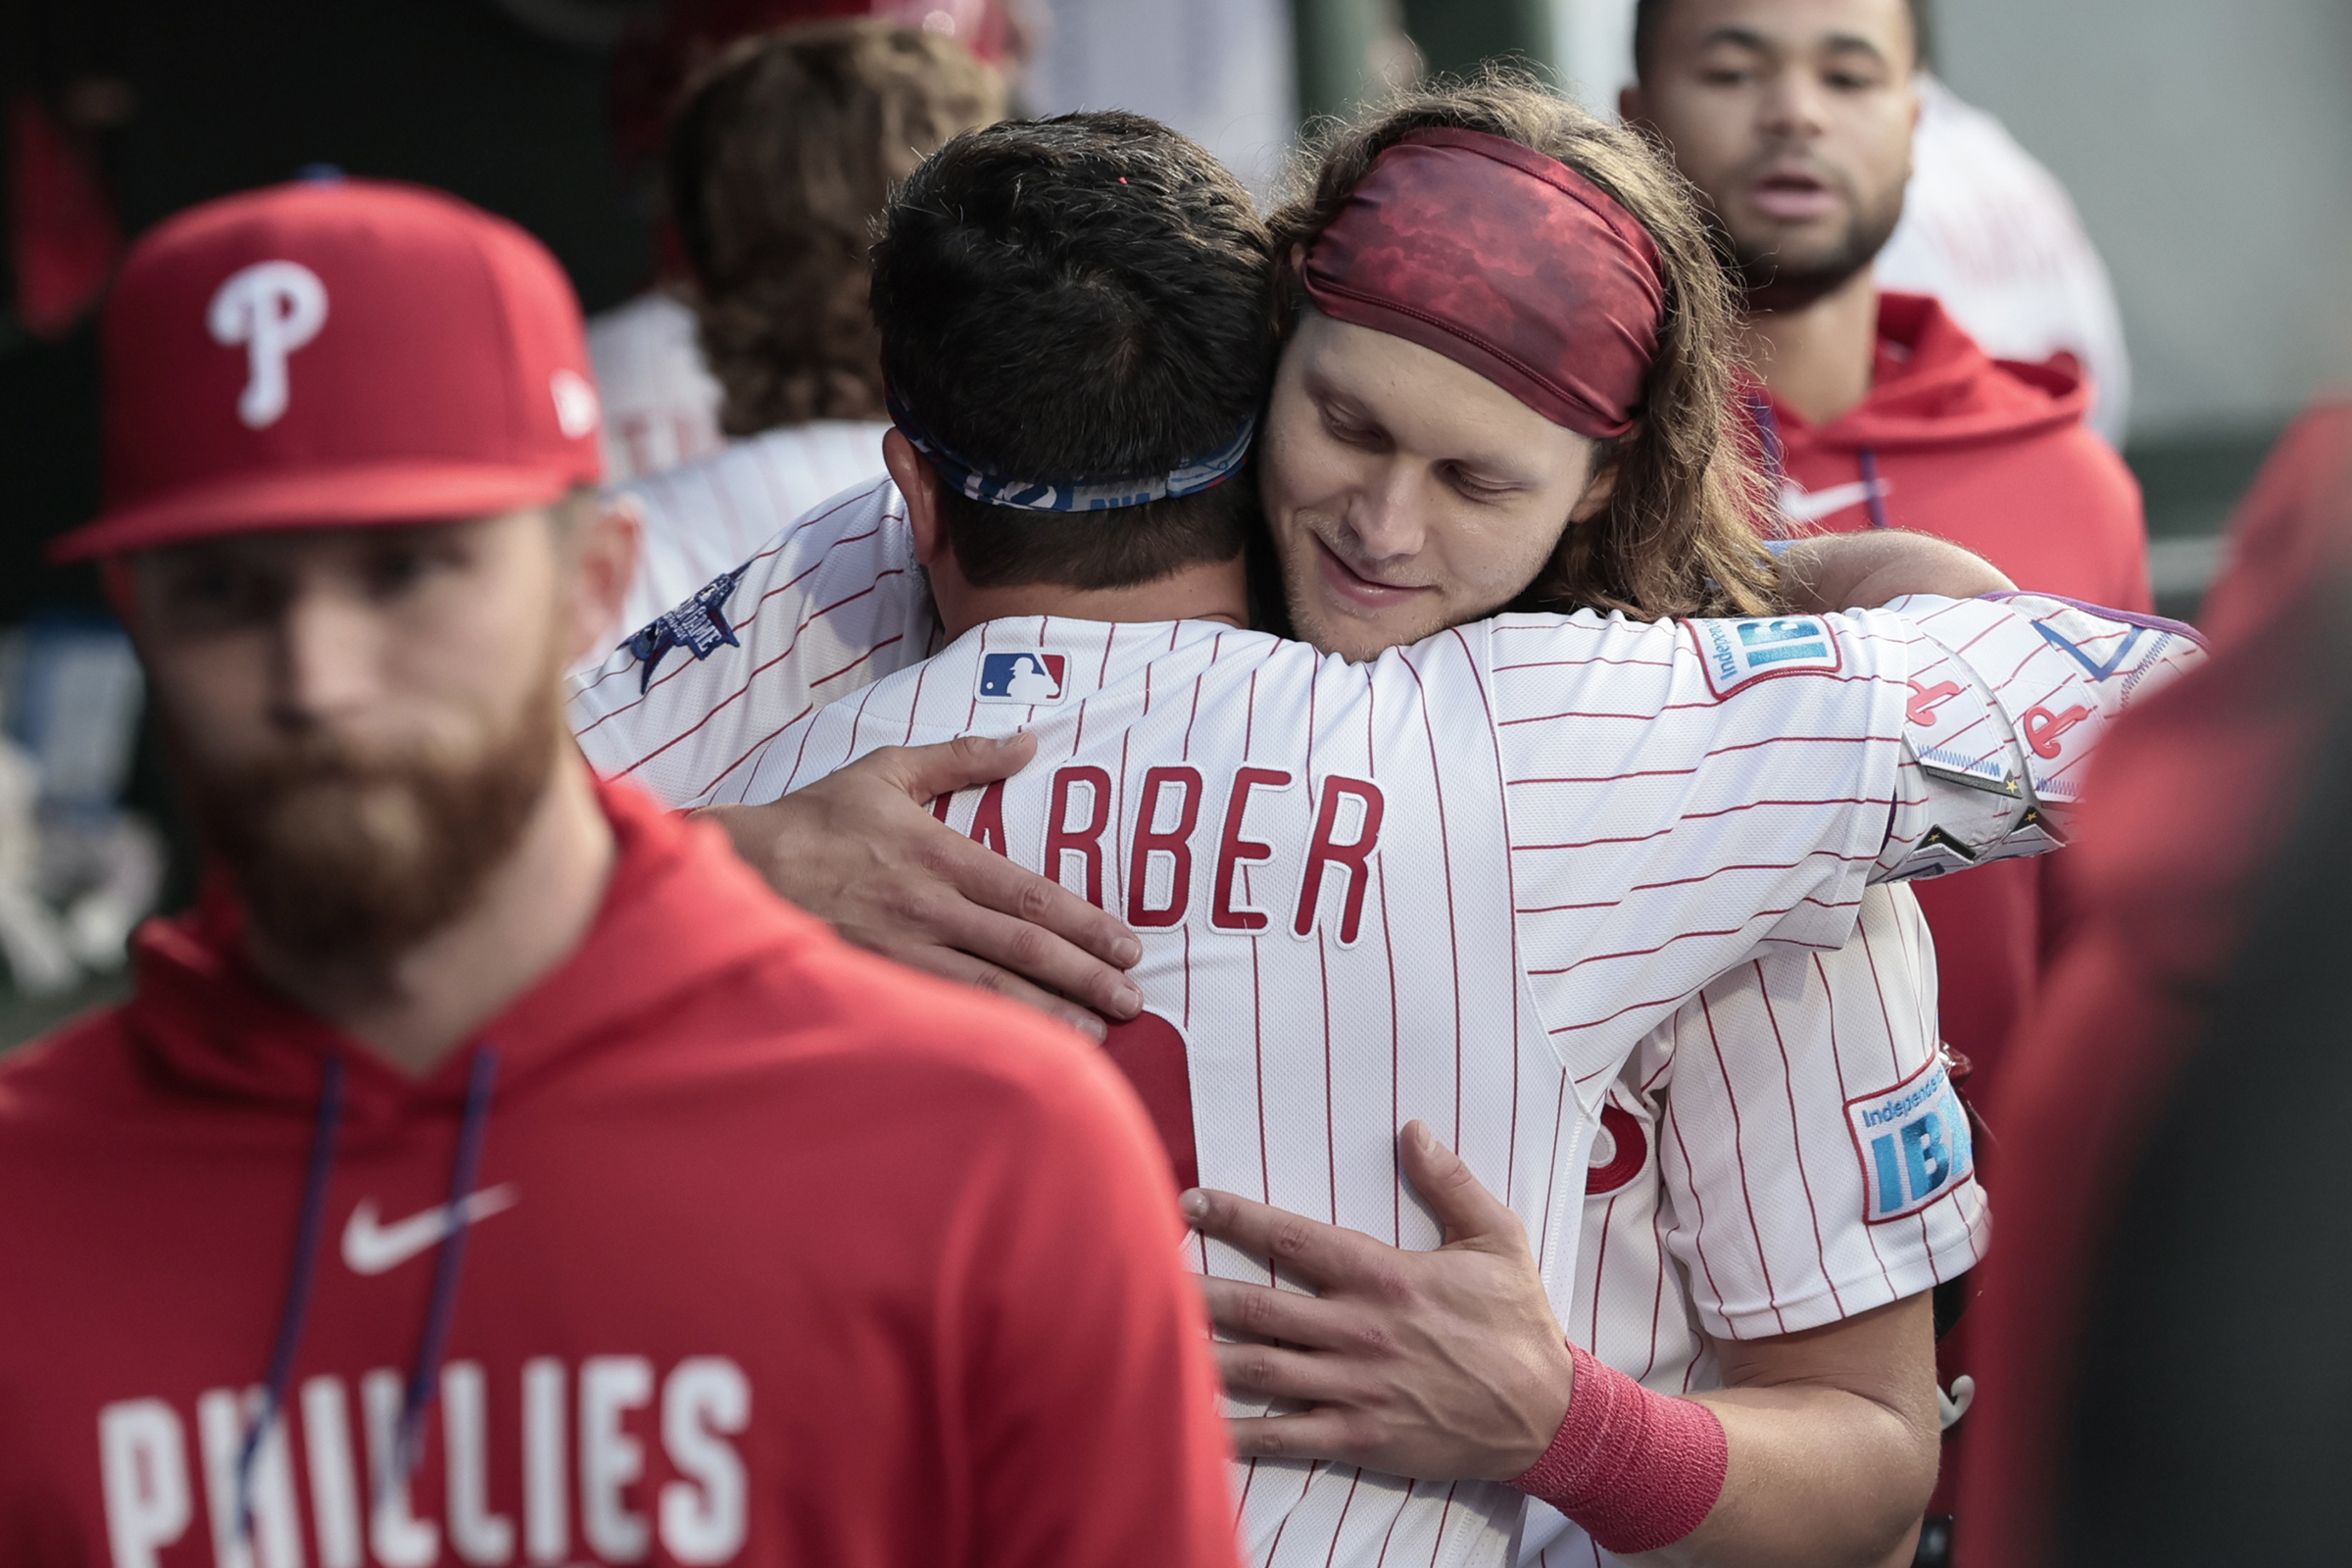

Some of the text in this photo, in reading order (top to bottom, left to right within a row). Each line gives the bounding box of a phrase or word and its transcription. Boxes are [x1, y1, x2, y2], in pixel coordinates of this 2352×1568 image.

[205, 269, 330, 431] P
[2024, 704, 2089, 760] P
[931, 763, 1387, 947] ARBER
[98, 1355, 753, 1568] PHILLIES
